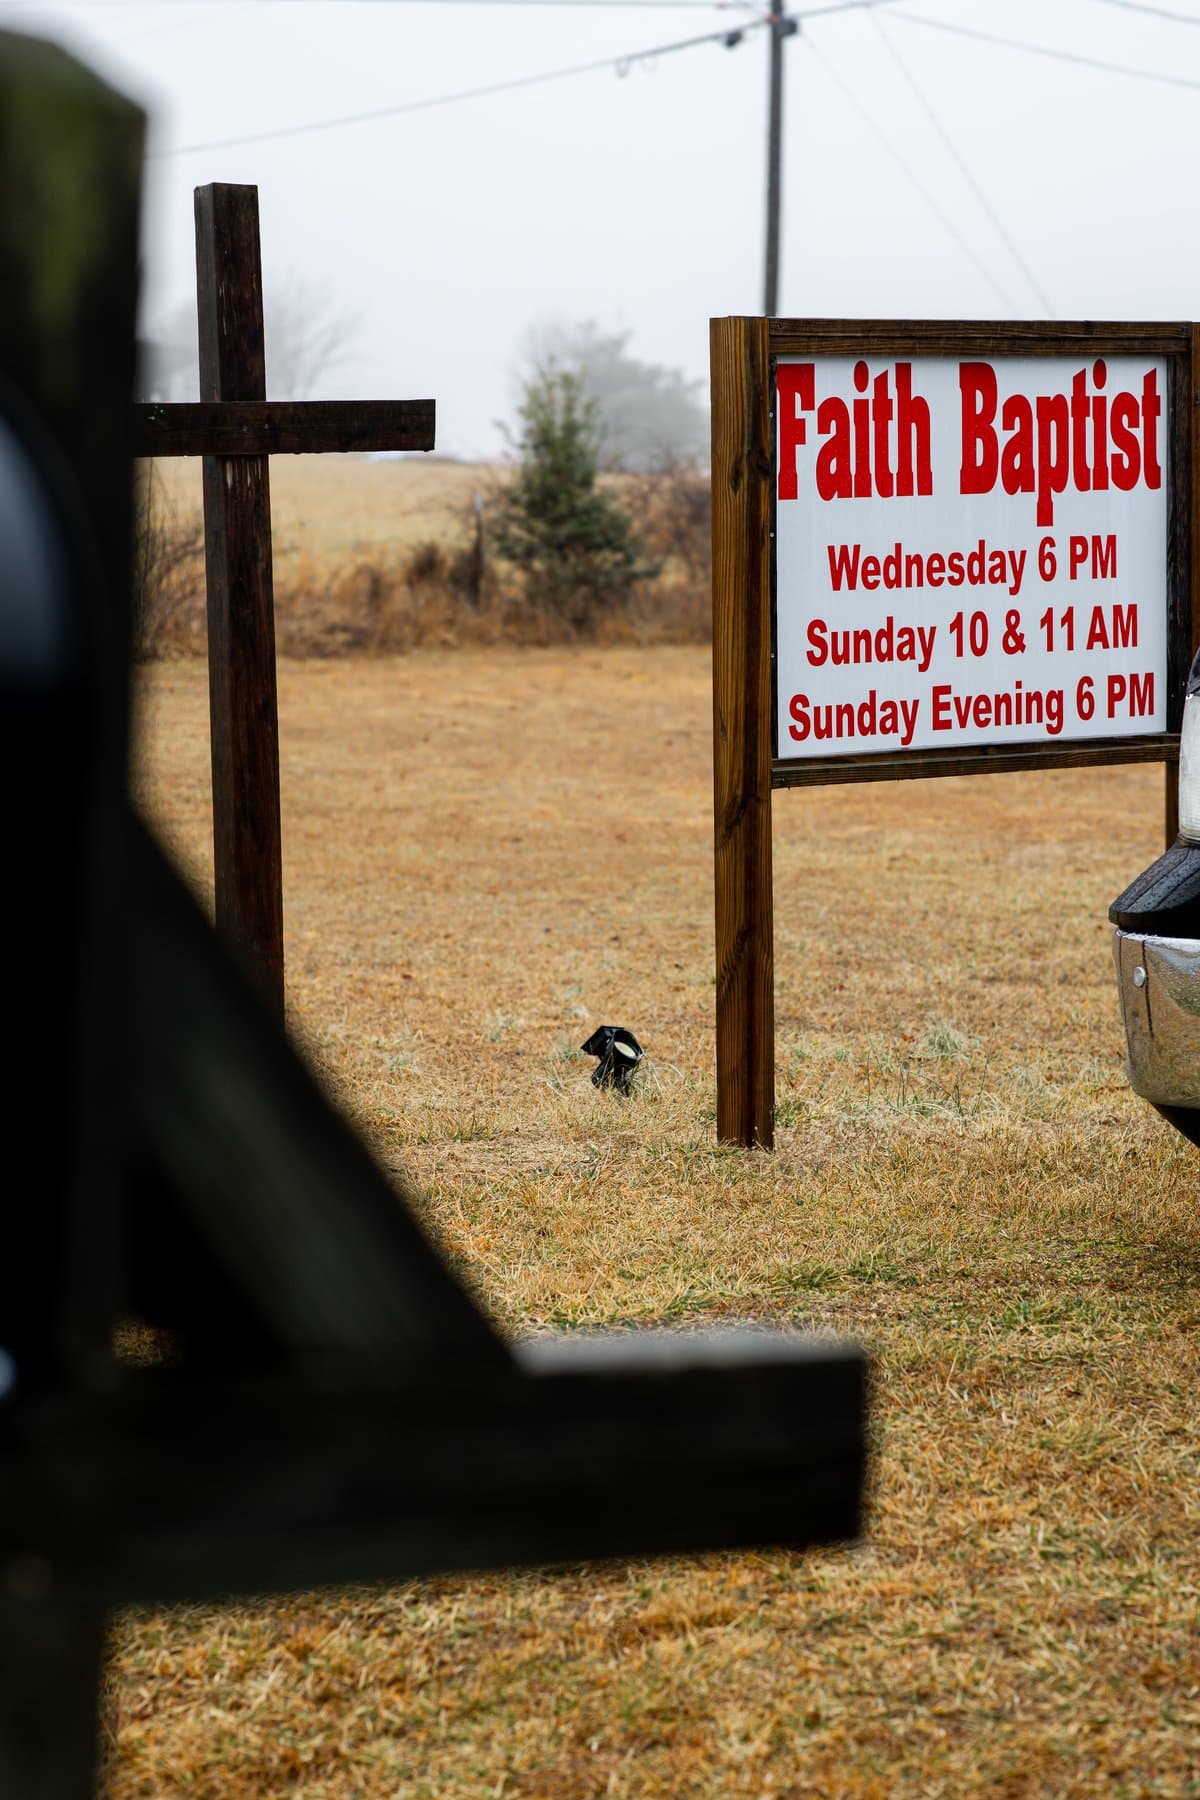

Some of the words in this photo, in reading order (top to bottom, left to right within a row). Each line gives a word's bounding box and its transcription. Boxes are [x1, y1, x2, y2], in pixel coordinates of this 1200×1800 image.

[777, 360, 933, 501] Faith
[959, 358, 1162, 527] Baptist
[828, 540, 1027, 596] Wednesday
[1039, 536, 1057, 582] 6
[1070, 535, 1117, 580] PM
[806, 616, 936, 672] Sunday
[949, 610, 989, 657] 10
[1002, 609, 1026, 655] &
[1040, 606, 1074, 653] 11
[1086, 604, 1138, 651] AM
[789, 690, 919, 745] Sunday
[932, 681, 1064, 735] Evening
[1076, 676, 1094, 721] 6
[1108, 672, 1155, 719] PM
